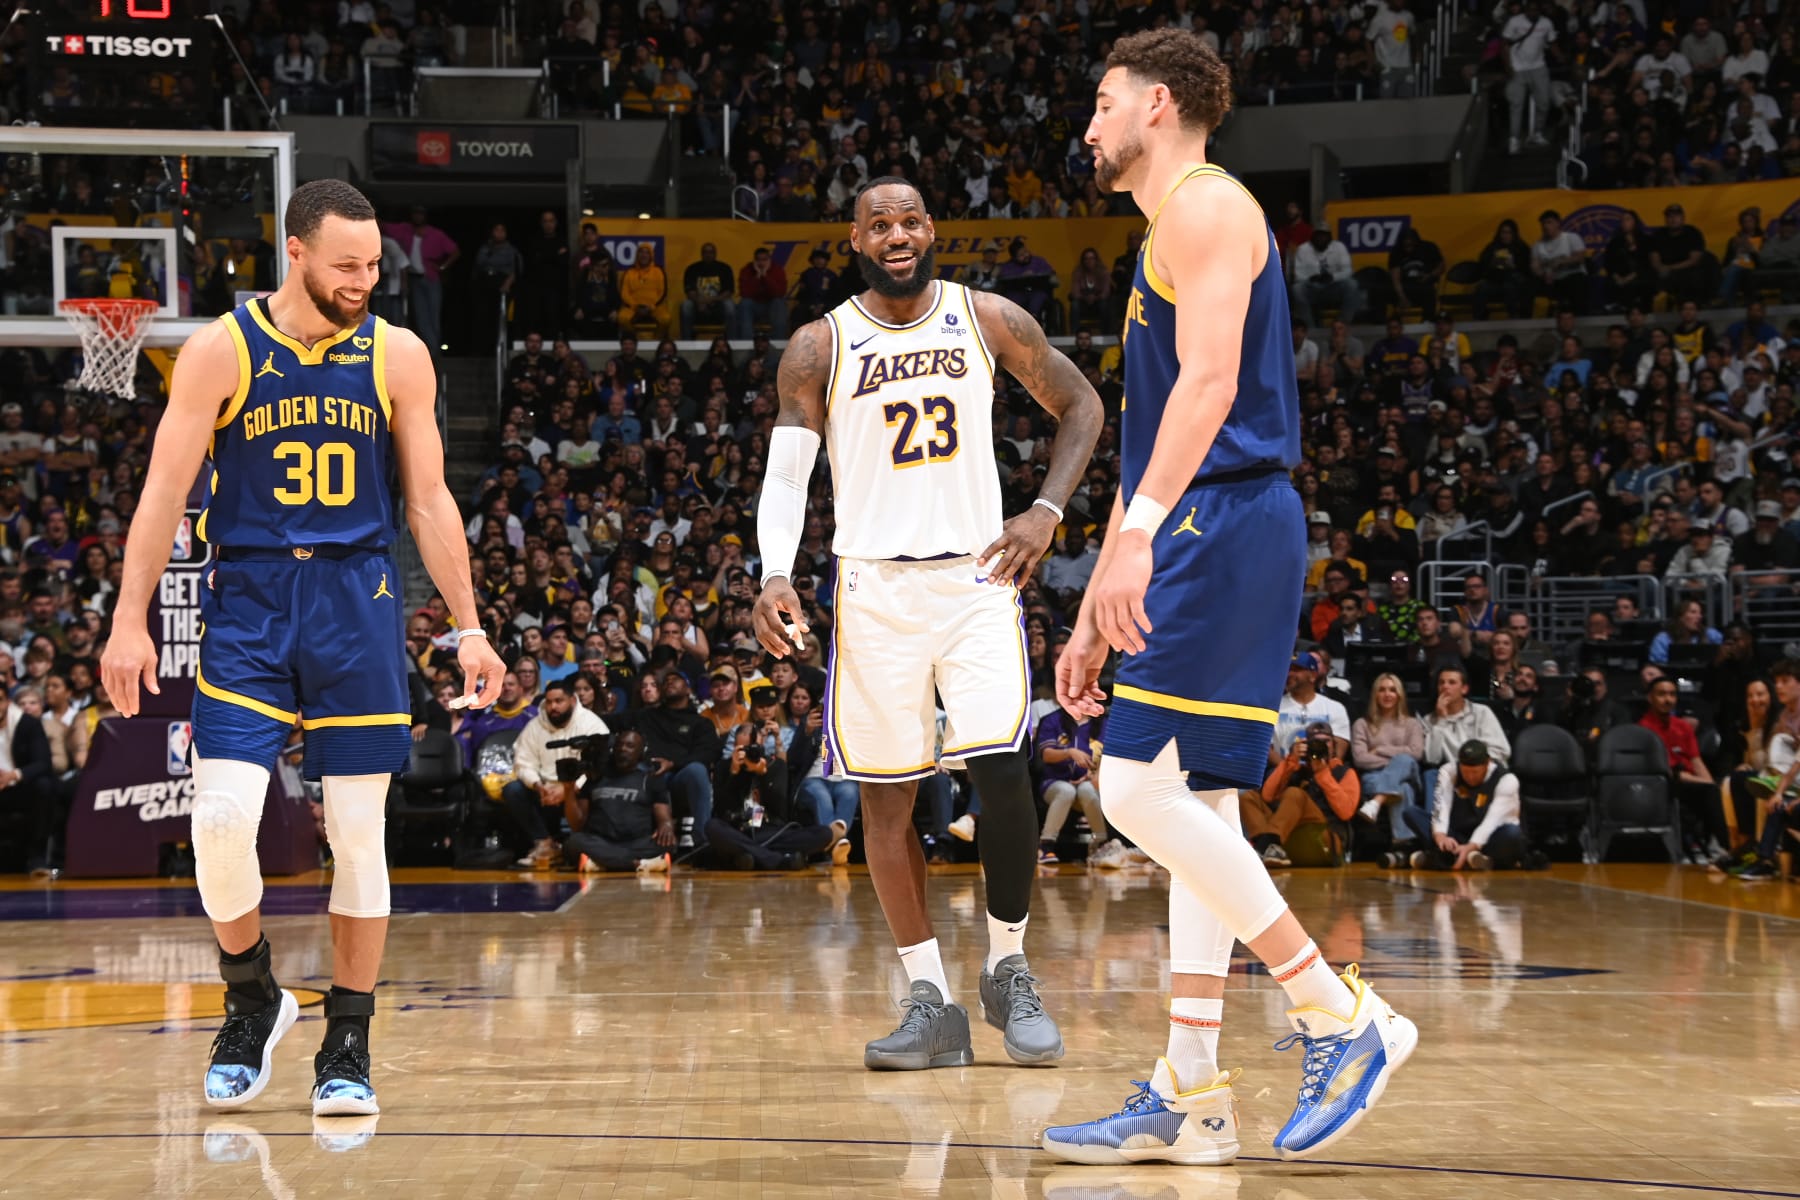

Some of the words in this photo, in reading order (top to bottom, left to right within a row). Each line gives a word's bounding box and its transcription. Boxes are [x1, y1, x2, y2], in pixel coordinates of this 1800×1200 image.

[86, 36, 191, 57] TISSOT
[457, 141, 533, 157] TOYOTA
[1345, 220, 1403, 248] 107
[941, 326, 967, 338] bibigo
[328, 353, 370, 363] Rakuten
[850, 347, 968, 400] LAKERS
[243, 395, 318, 441] GOLDEN
[882, 394, 961, 471] 23
[273, 441, 356, 507] 30
[159, 572, 201, 606] GET
[159, 608, 202, 642] THE
[158, 644, 200, 678] APP
[93, 778, 195, 811] EVERYO
[138, 796, 193, 822] GAM
